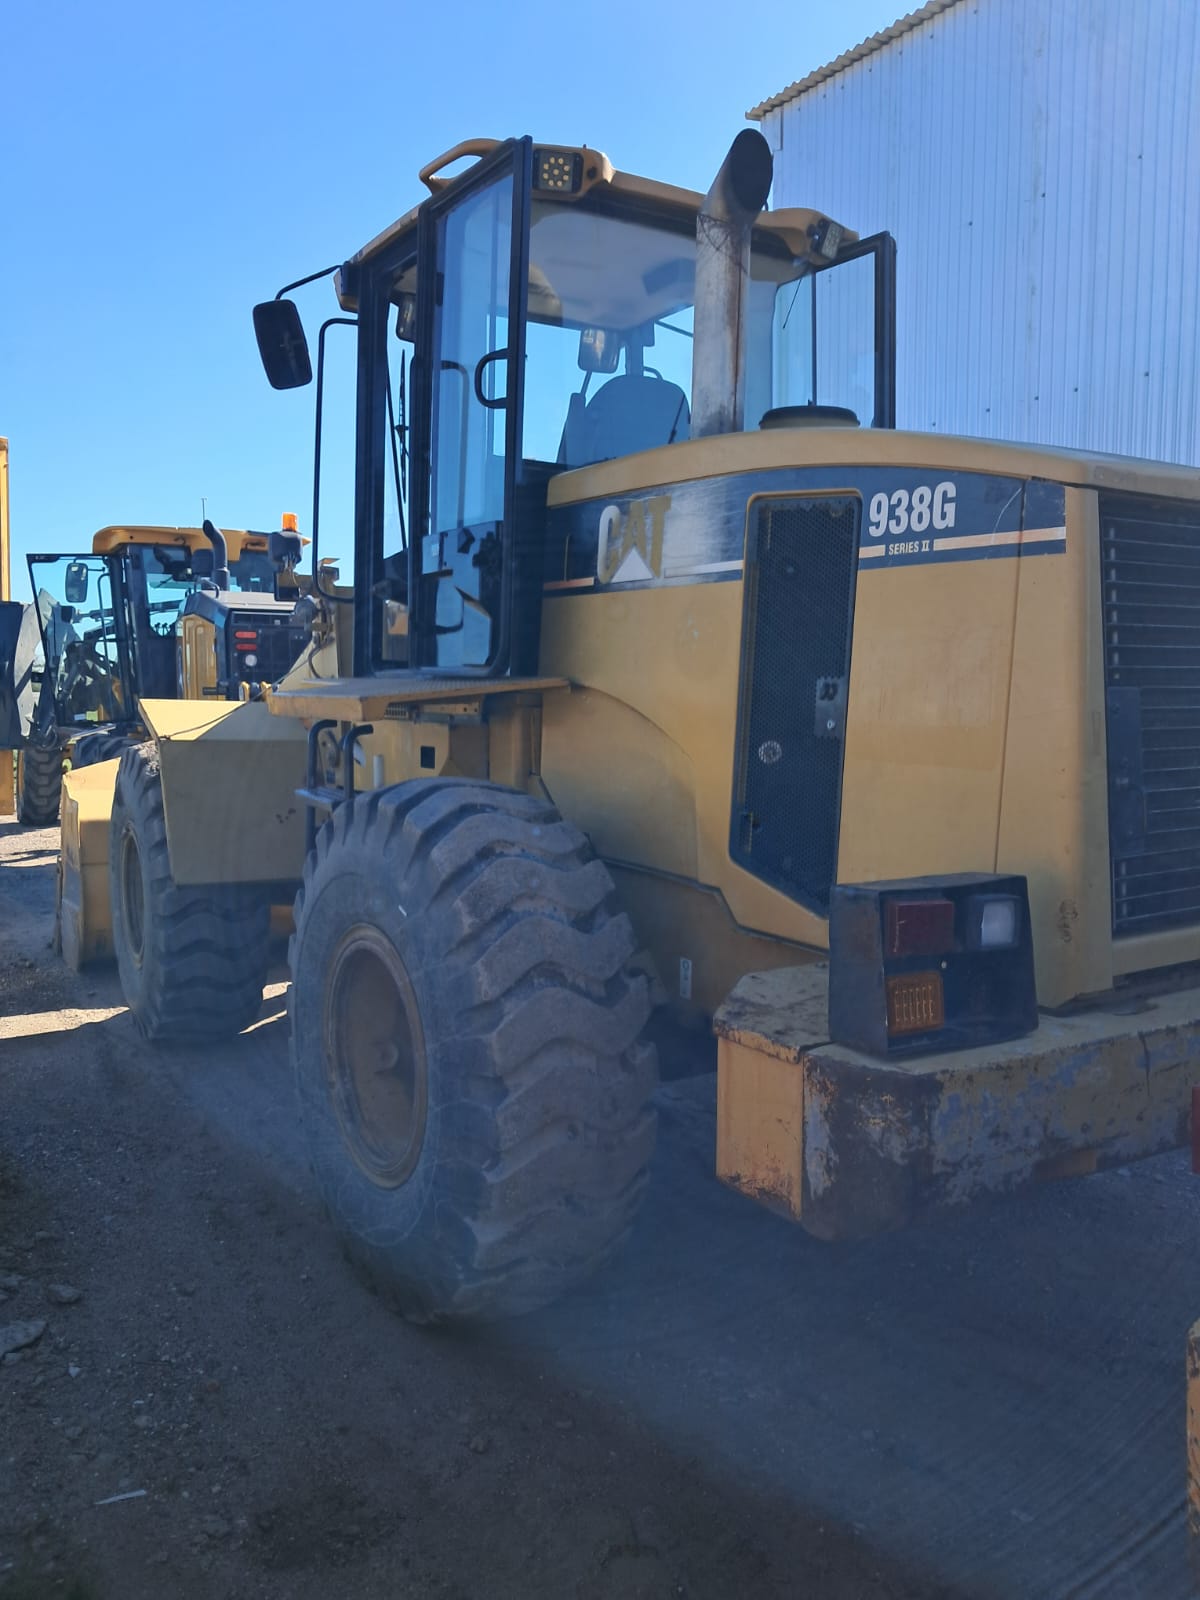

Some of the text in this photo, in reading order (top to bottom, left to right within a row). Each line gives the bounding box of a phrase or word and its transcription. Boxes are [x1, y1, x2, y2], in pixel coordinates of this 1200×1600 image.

[868, 481, 957, 537] 938G
[597, 494, 672, 584] CAT
[888, 540, 930, 556] SERIES II
